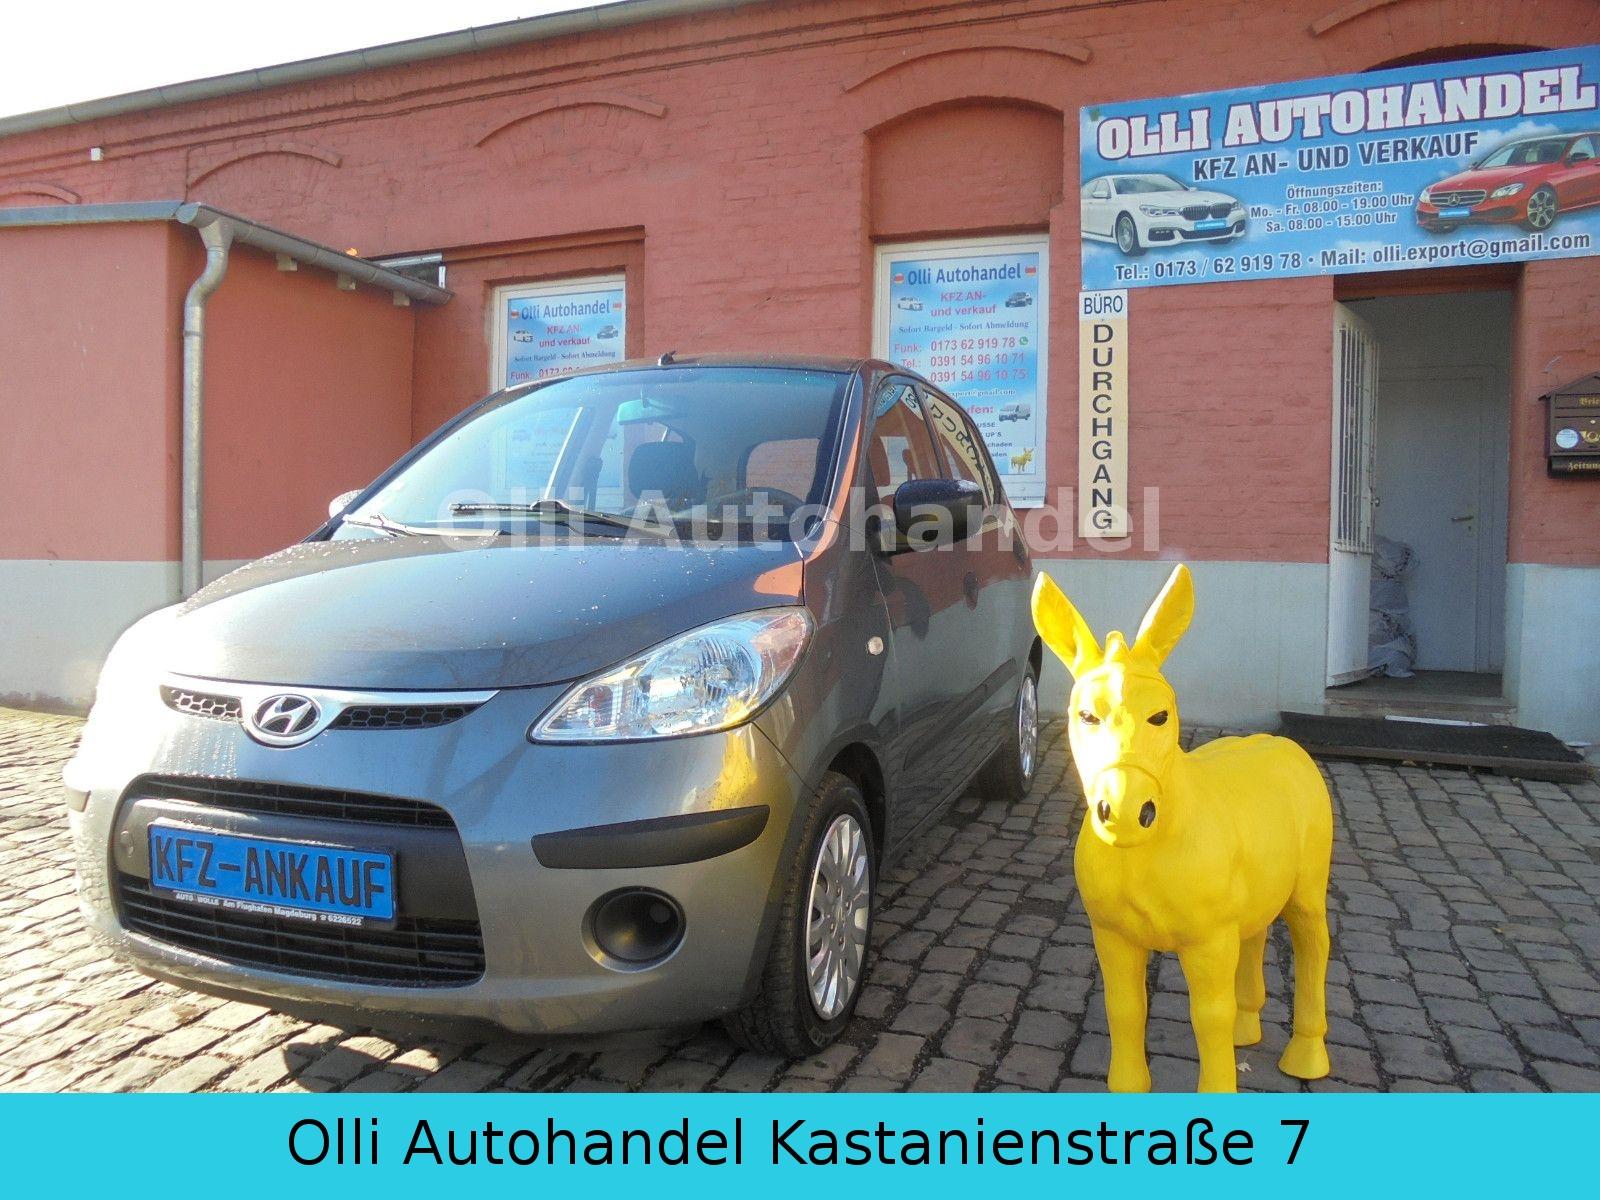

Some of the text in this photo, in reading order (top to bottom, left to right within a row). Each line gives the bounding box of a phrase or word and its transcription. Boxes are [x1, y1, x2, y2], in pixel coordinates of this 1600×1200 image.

[1097, 64, 1598, 160] OLLI AUTOHANDEL
[1194, 132, 1479, 181] KFZ AN- UND VERKAUF
[1287, 181, 1382, 199] Öffnungszeiten:
[1250, 207, 1273, 218] Mo.
[1285, 203, 1300, 215] Fr.
[1303, 200, 1338, 214] 08.00
[1352, 196, 1387, 210] 19.00
[1391, 194, 1414, 206] Uhr
[1266, 221, 1285, 232] Sa.
[1288, 218, 1323, 231] 08.00
[1336, 214, 1371, 227] 15.00
[1375, 212, 1397, 224] Uhr
[1116, 264, 1148, 280] Tel.:
[1154, 260, 1197, 278] 0173
[1213, 257, 1235, 273] 62
[1240, 254, 1273, 272] 919
[1279, 252, 1301, 269] 78
[1321, 249, 1366, 267] Mail:
[1372, 233, 1590, 264] olli.export@gmail.com
[908, 263, 1021, 286] Olli Autohandel
[941, 291, 962, 302] KFZ
[1084, 293, 1123, 315] BÜRO
[521, 299, 610, 320] Olli Autohandel
[931, 303, 997, 317] und verkauf
[985, 319, 1029, 330] Abmeldung
[539, 336, 591, 347] und verkauf
[930, 339, 957, 352] 0173
[961, 338, 974, 350] 62
[977, 337, 998, 349] 919
[1002, 336, 1016, 348] 78
[930, 355, 956, 367] 0391
[960, 354, 974, 366] 54
[930, 370, 956, 382] 0391
[960, 369, 974, 381] 54
[1091, 323, 1114, 530] DURCHGANG
[156, 834, 386, 909] KFZ-ANKAUF
[274, 905, 317, 922] Magdeburg
